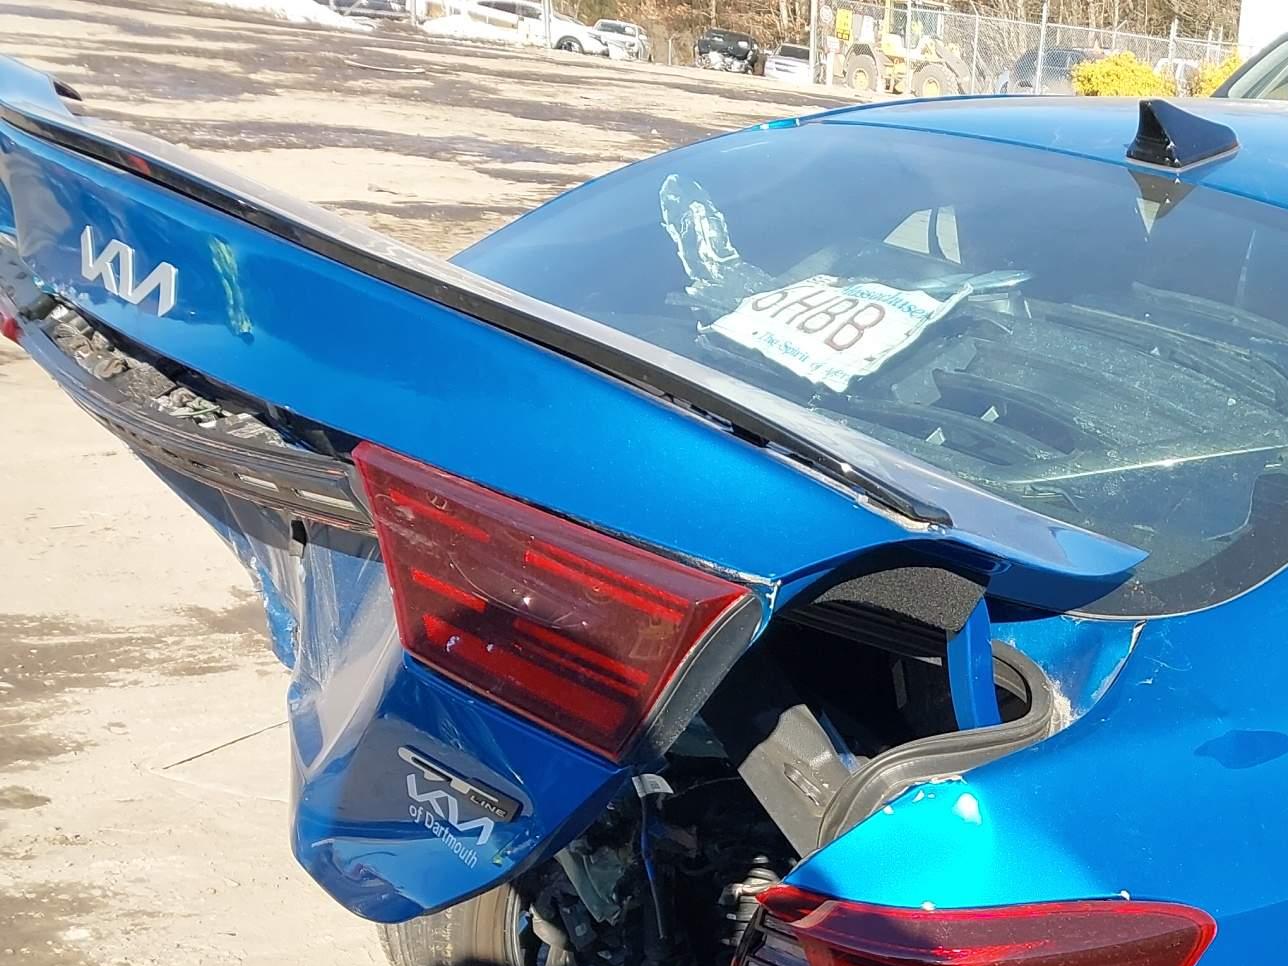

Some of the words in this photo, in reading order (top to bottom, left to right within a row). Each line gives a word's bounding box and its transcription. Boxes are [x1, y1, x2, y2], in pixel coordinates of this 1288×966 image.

[81, 225, 178, 317] KIA
[778, 340, 811, 363] Spirit
[407, 774, 494, 845] KIA
[409, 805, 423, 823] of
[424, 810, 478, 870] Dartmouth
[470, 795, 506, 818] LINE
